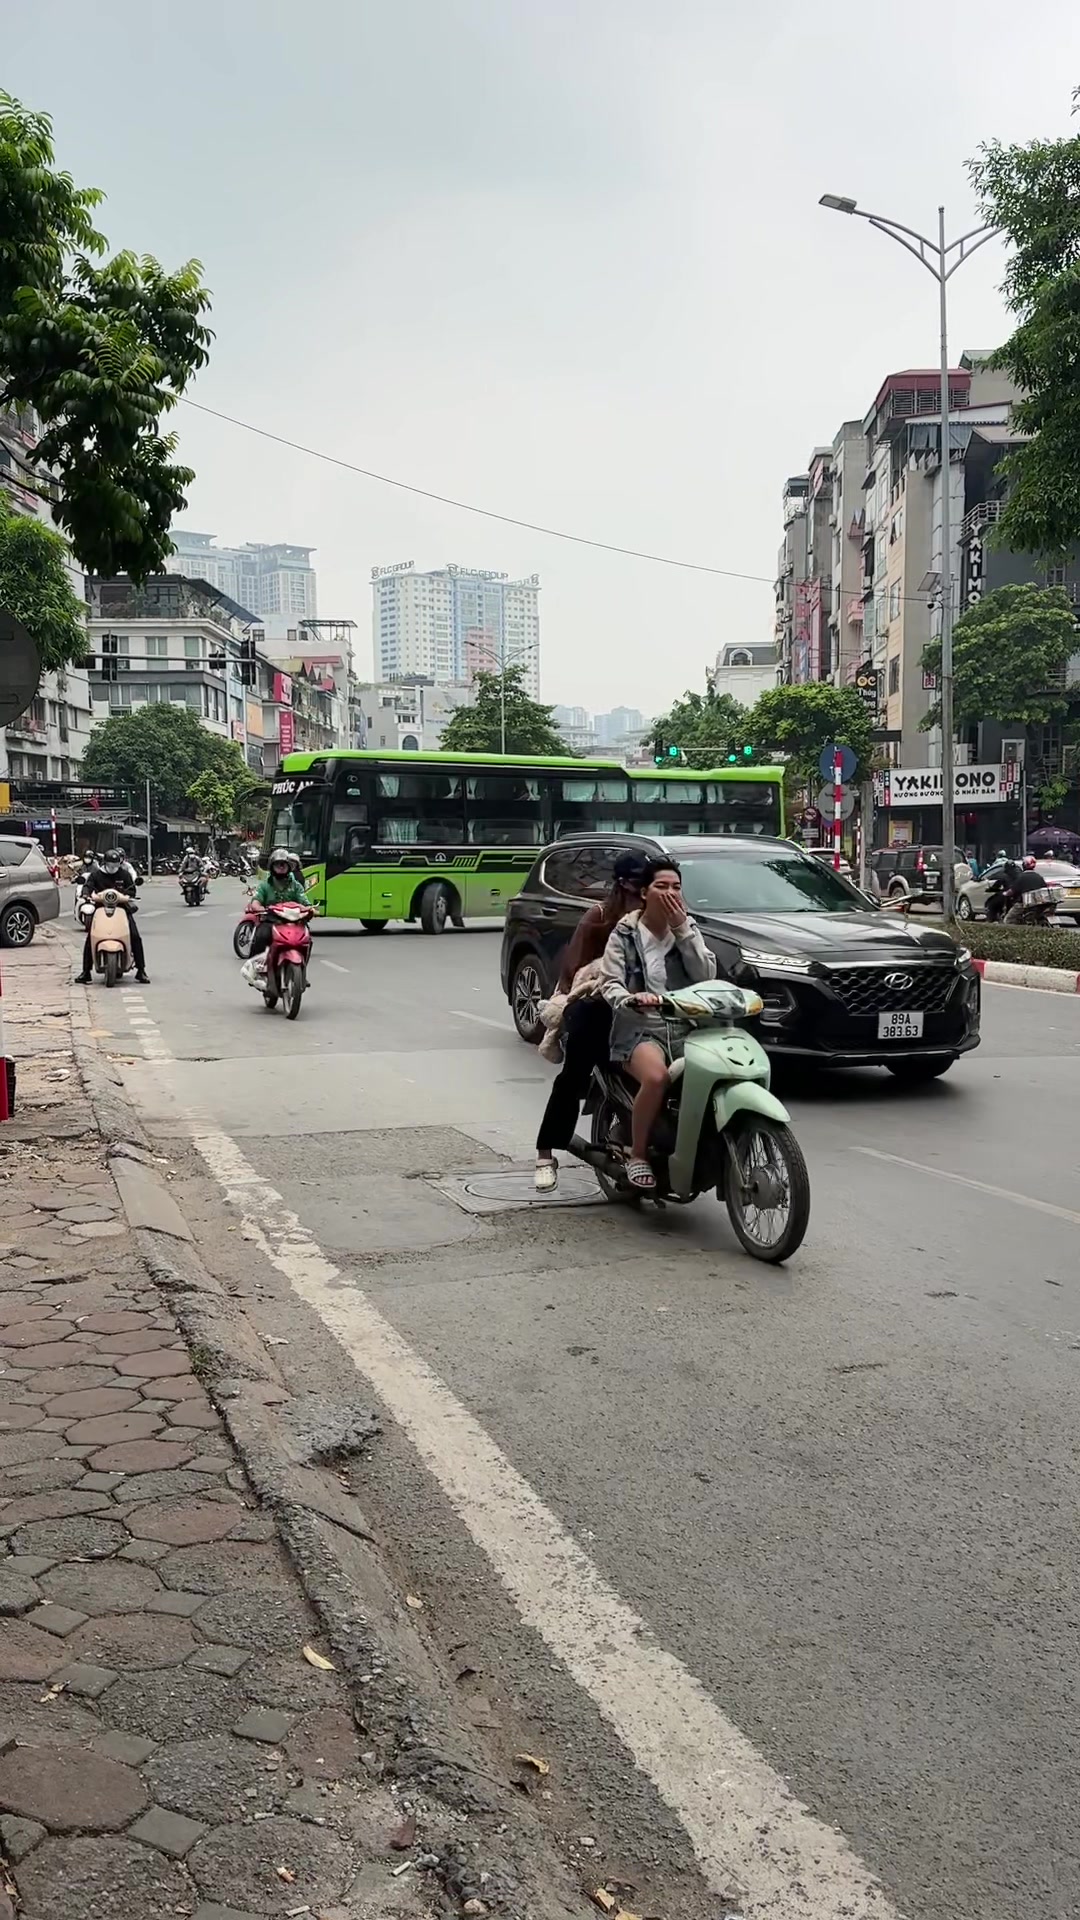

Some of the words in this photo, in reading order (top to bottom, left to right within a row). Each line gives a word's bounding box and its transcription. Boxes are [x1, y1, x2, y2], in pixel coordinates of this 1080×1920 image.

[379, 565, 392, 576] FLC
[392, 560, 415, 573] GROUP
[460, 567, 477, 577] FLC
[478, 569, 509, 581] GROUP
[272, 779, 295, 795] PHÚC
[894, 772, 996, 790] YAKIONO
[891, 1013, 911, 1025] 89A
[883, 1025, 919, 1037] 383.63
